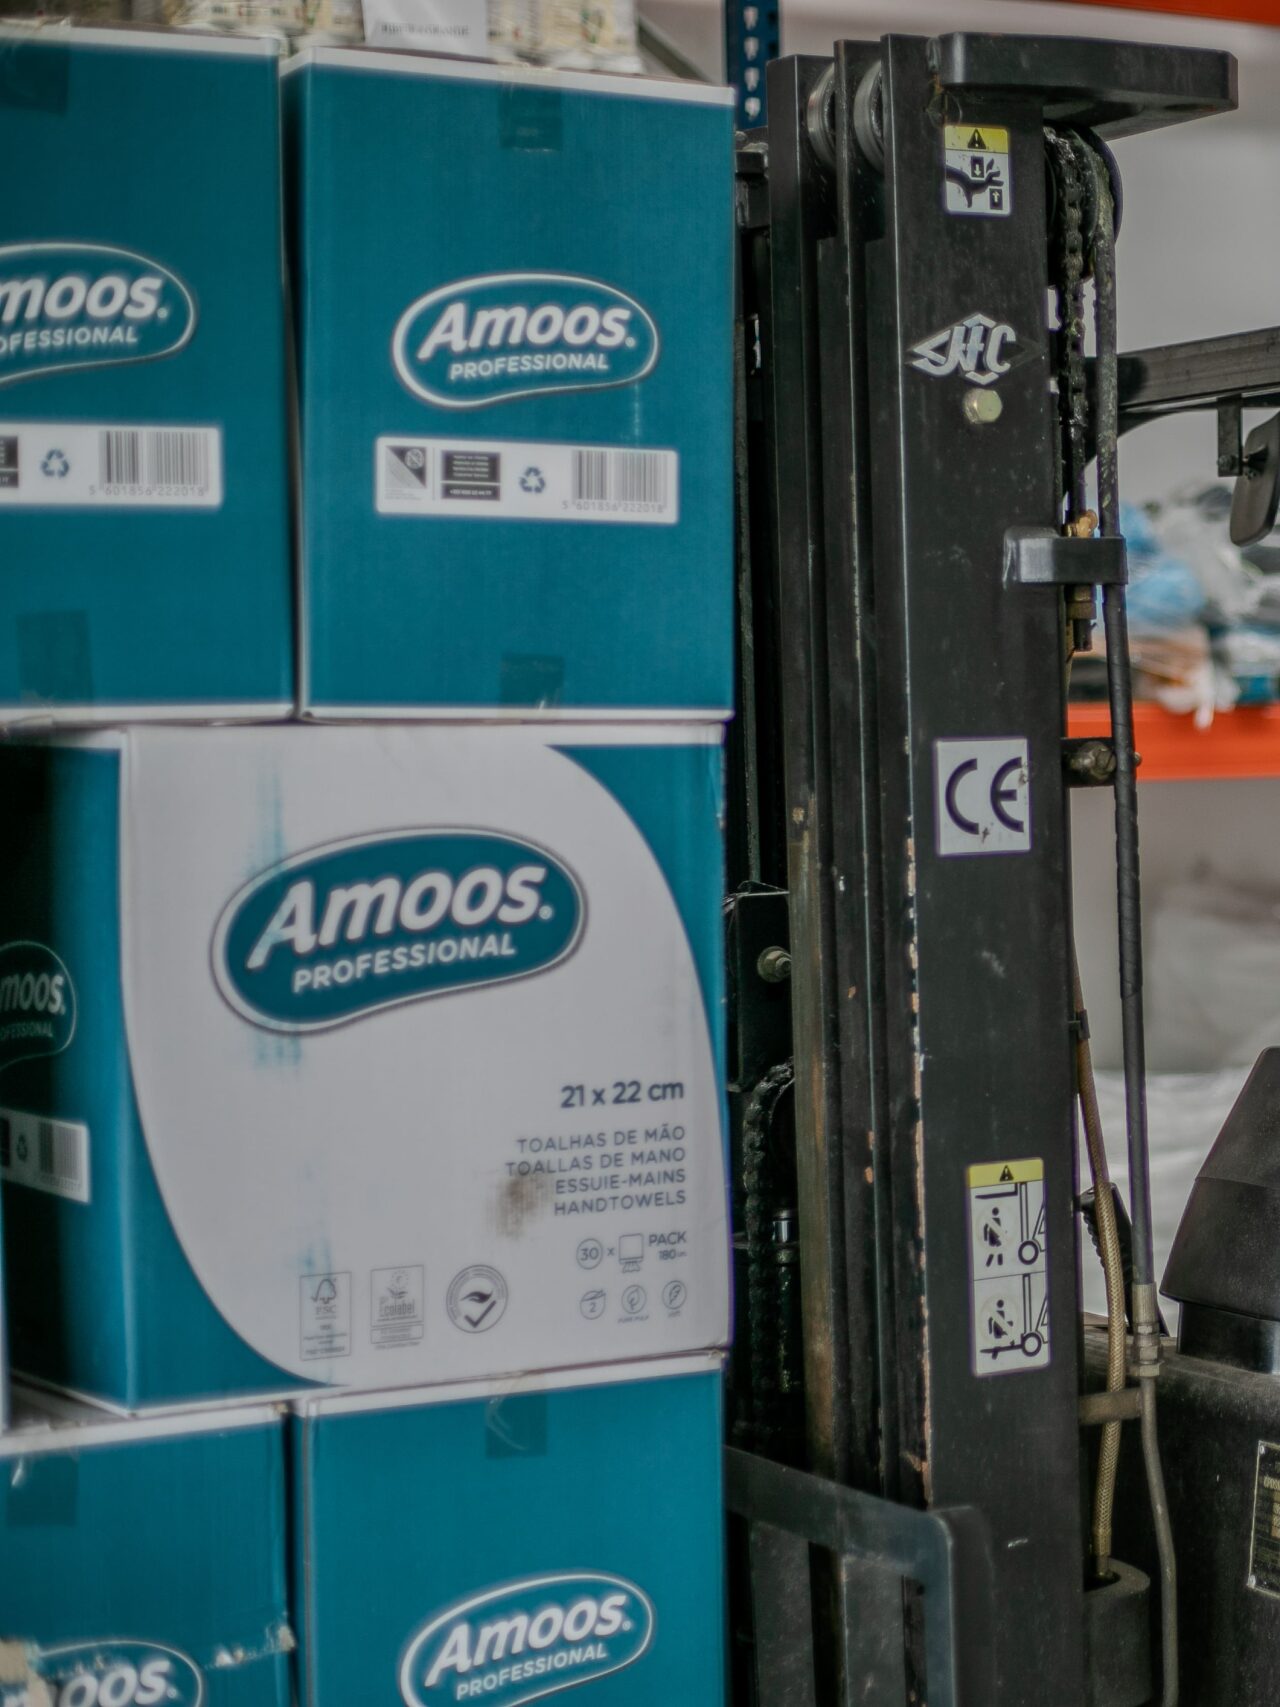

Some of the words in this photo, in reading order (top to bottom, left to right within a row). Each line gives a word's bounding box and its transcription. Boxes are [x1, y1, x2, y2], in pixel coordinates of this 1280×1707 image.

[0, 276, 164, 322] moos
[450, 353, 609, 380] PROFESSIONAL
[945, 757, 1024, 835] CE
[293, 934, 516, 993] PROFESSIONAL
[560, 1084, 585, 1108] 21
[591, 1088, 606, 1106] x
[612, 1081, 642, 1104] 22
[648, 1081, 684, 1101] cm
[516, 1133, 606, 1153] TOALHAS
[614, 1130, 637, 1146] DE
[644, 1123, 685, 1142] MÃO
[506, 1156, 593, 1176] TOALLAS
[600, 1152, 623, 1169] DE
[630, 1147, 685, 1165] MANO
[555, 1169, 685, 1194] ESSUIE-MAINS
[553, 1190, 686, 1216] HANDTOWELS
[648, 1231, 687, 1247] PACK
[580, 1247, 599, 1261] 30
[456, 1643, 607, 1701] PROFESSIONAL
